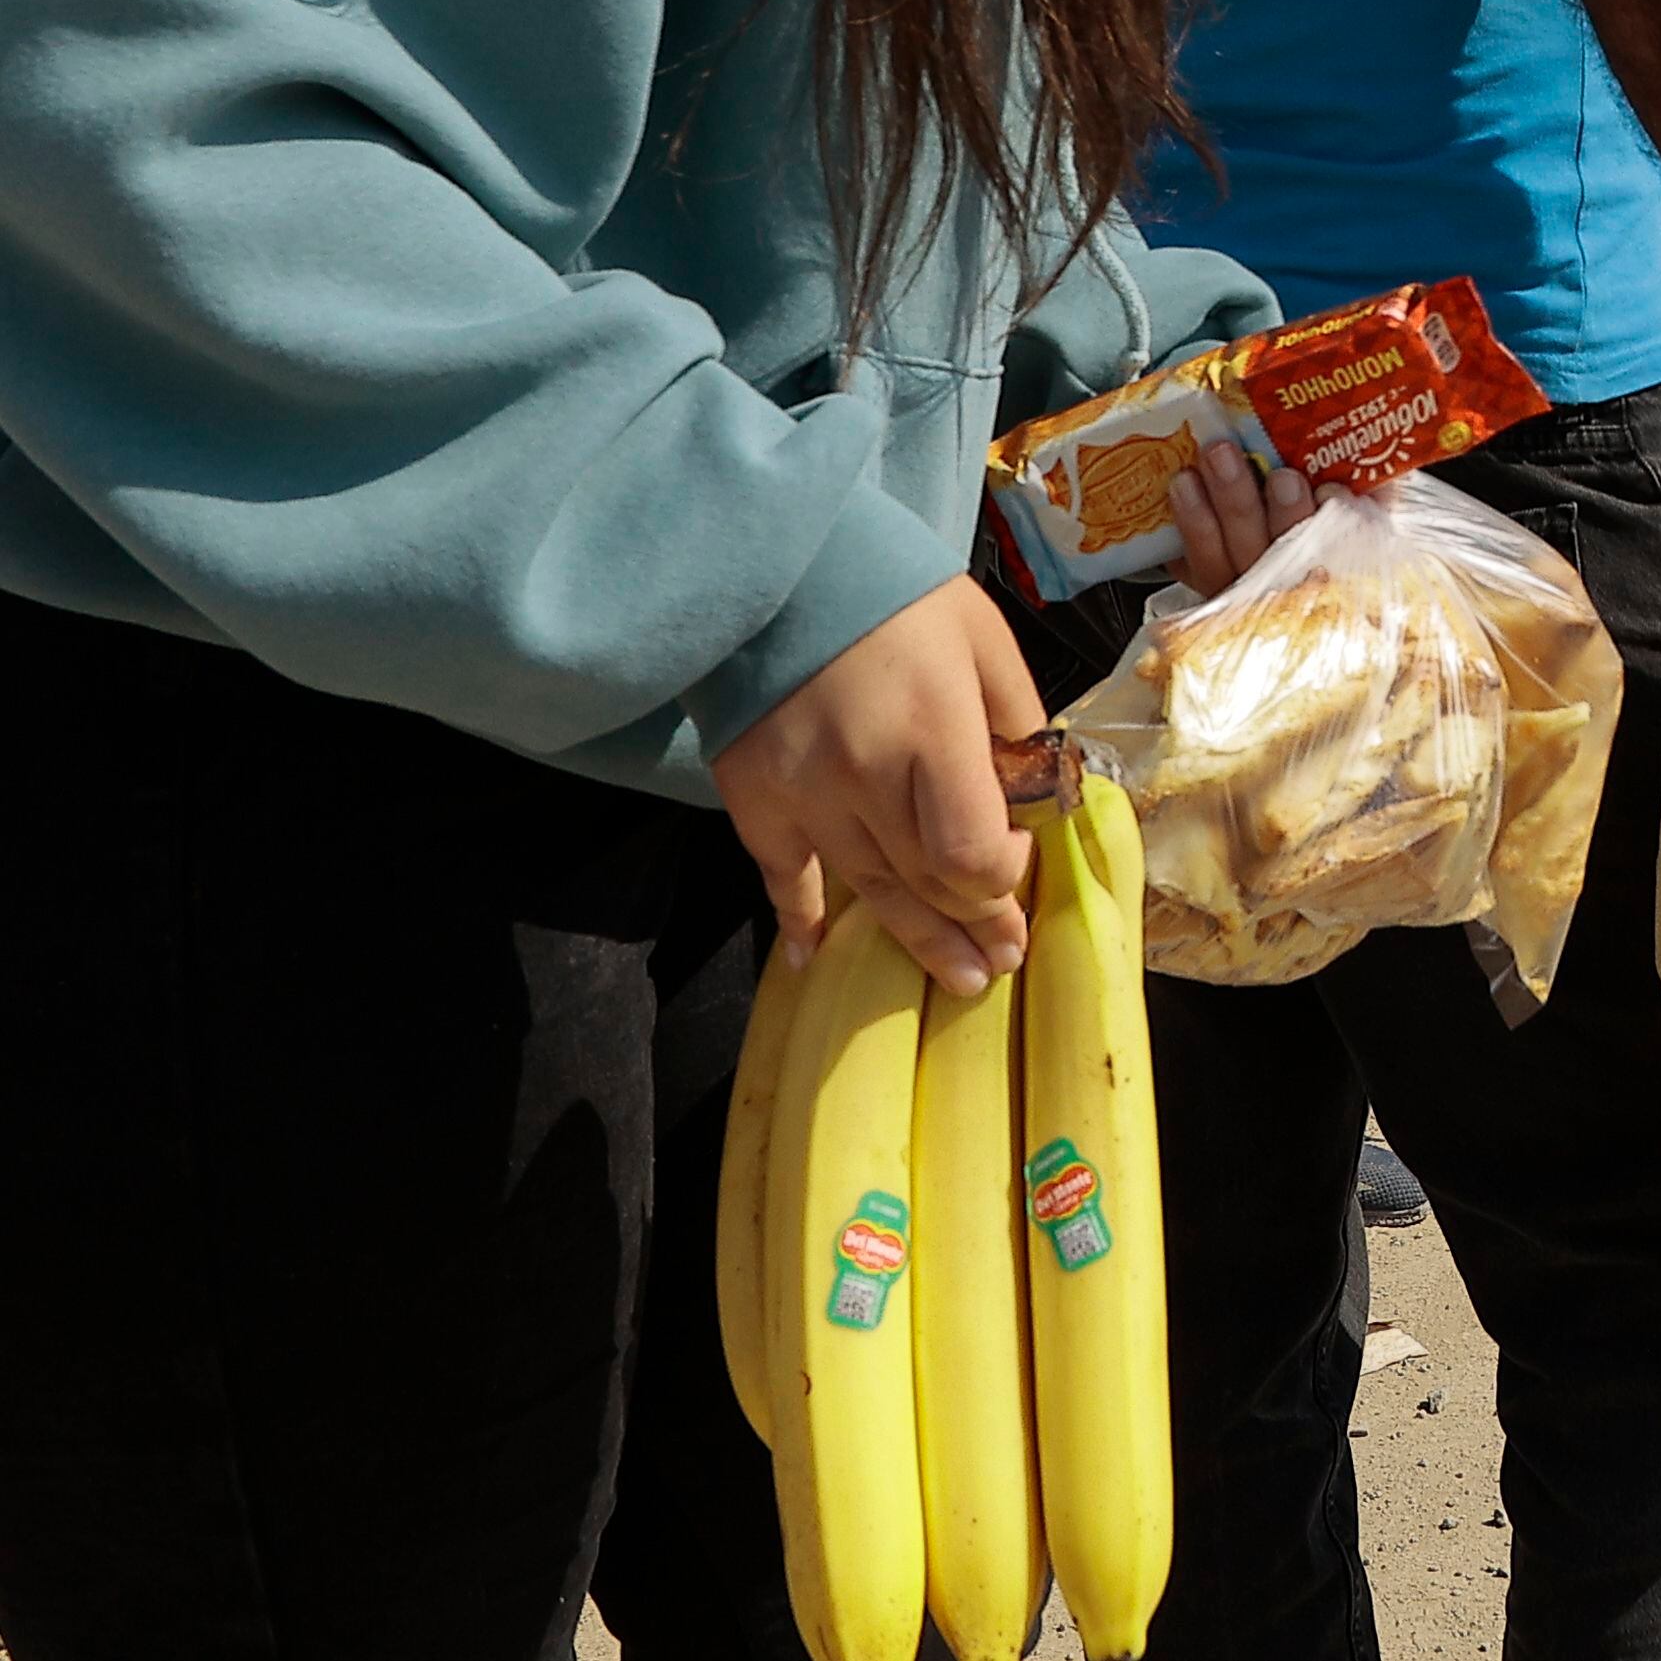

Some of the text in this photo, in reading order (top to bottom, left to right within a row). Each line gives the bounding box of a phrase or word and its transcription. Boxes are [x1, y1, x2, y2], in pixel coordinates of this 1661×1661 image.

[1276, 346, 1405, 410] МОЛОЧНОЕ
[1304, 388, 1439, 475] Юбилейное
[1347, 394, 1390, 427] 1913
